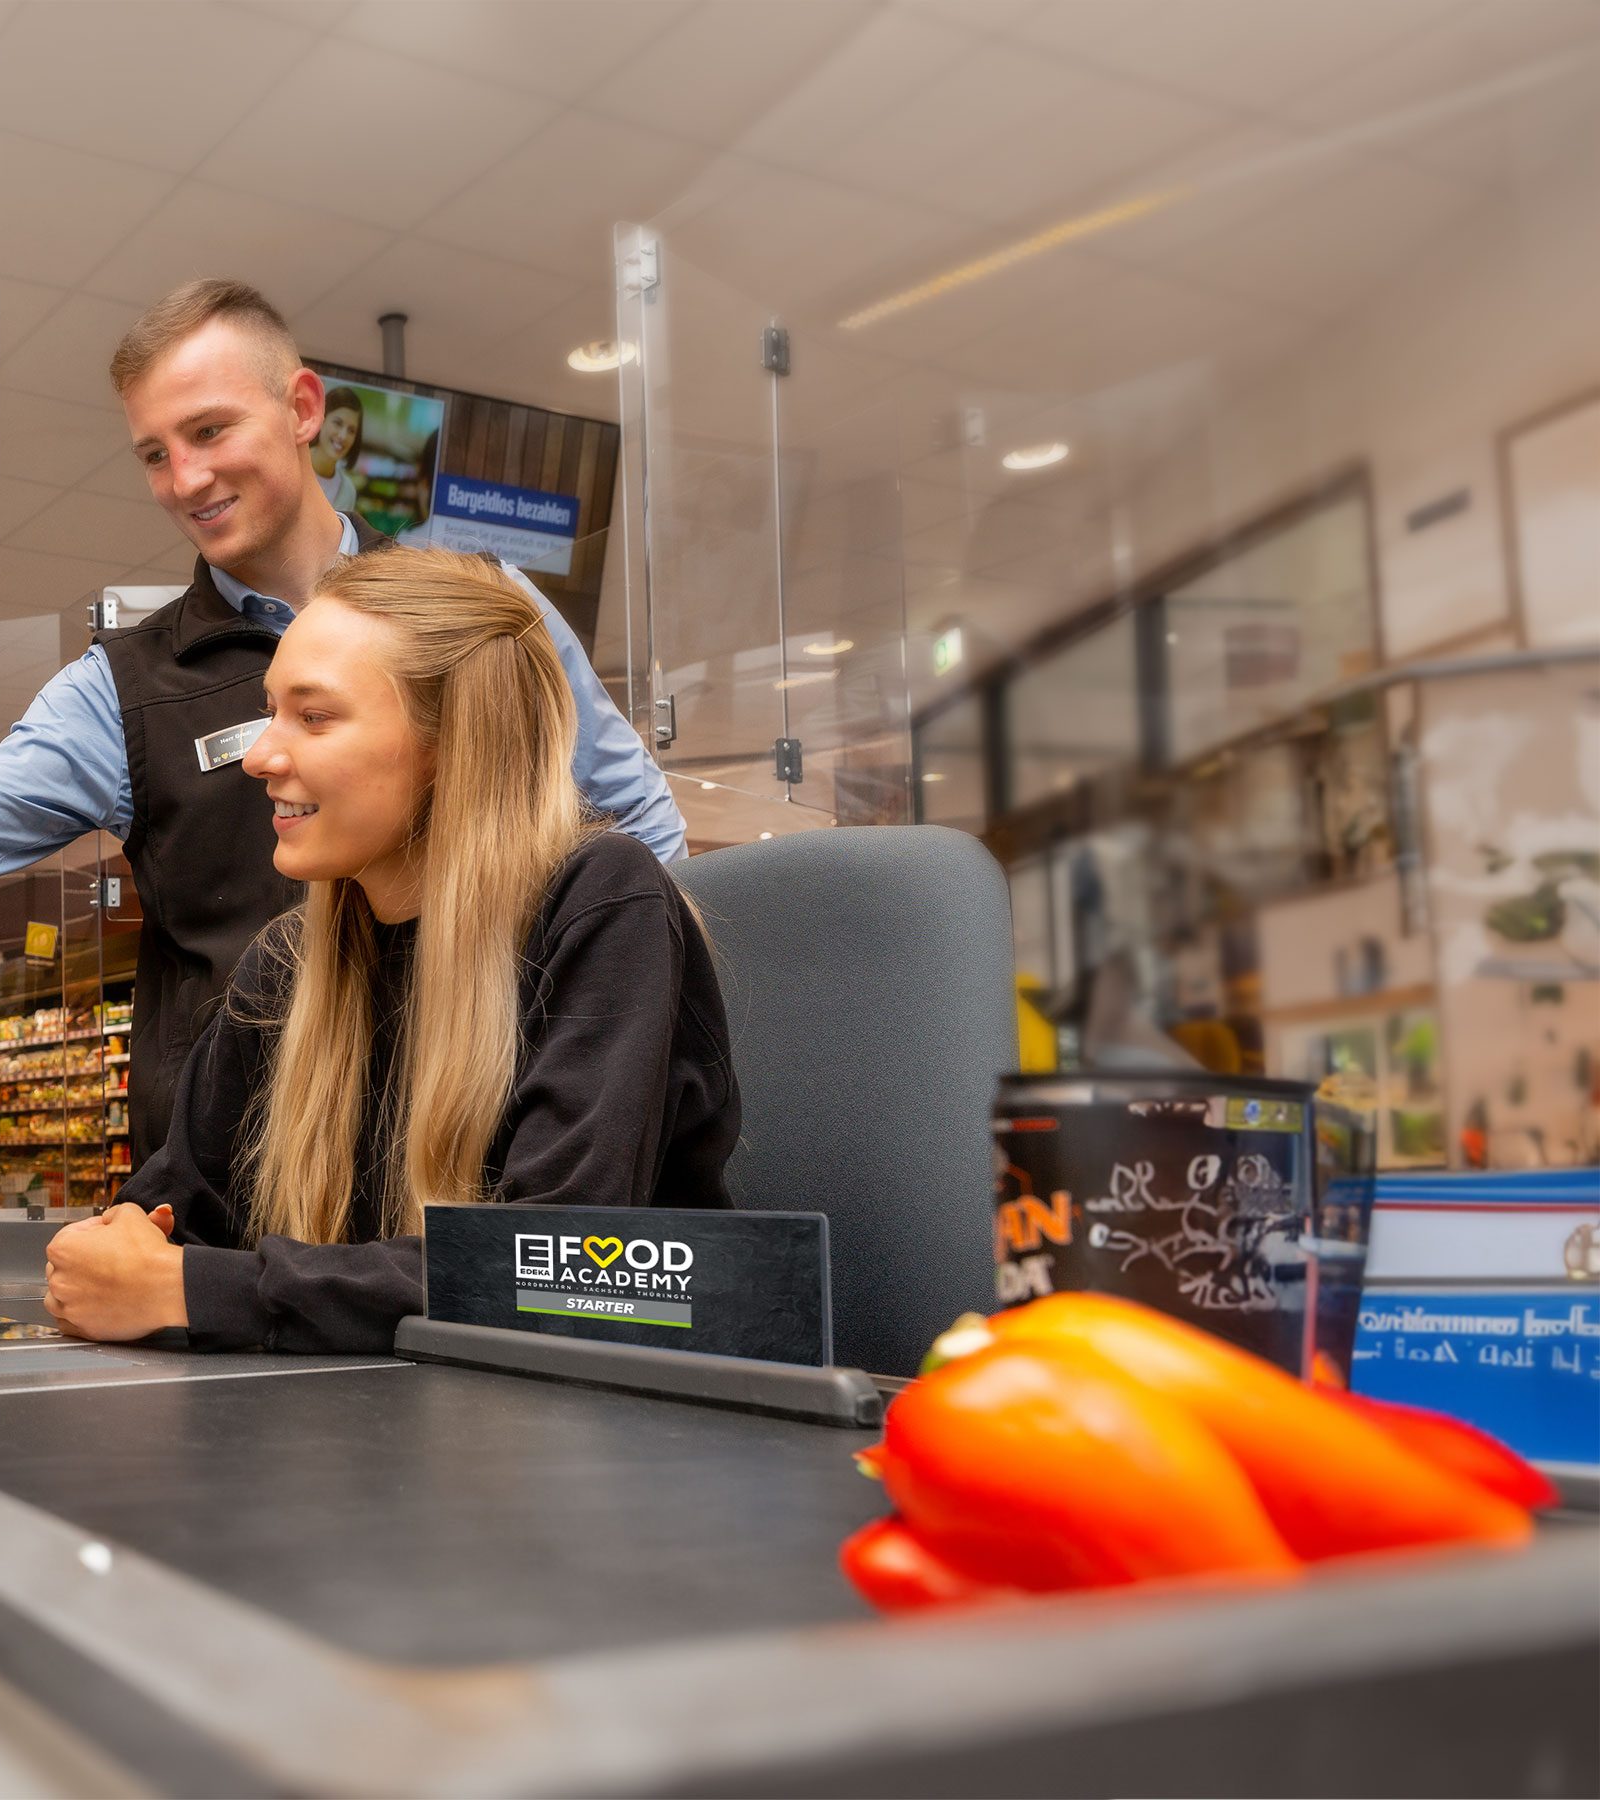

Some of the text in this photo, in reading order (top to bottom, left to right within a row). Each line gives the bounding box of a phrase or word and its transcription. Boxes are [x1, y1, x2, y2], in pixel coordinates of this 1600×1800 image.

[447, 483, 570, 526] Bargeldlos bezahlen
[220, 735, 234, 744] Herr
[520, 1268, 551, 1277] EDEKA
[559, 1266, 693, 1292] ACADEMY
[515, 1281, 693, 1300] NORDBAYERN SACHSEN THÜRINGEN
[566, 1298, 635, 1315] STARTER
